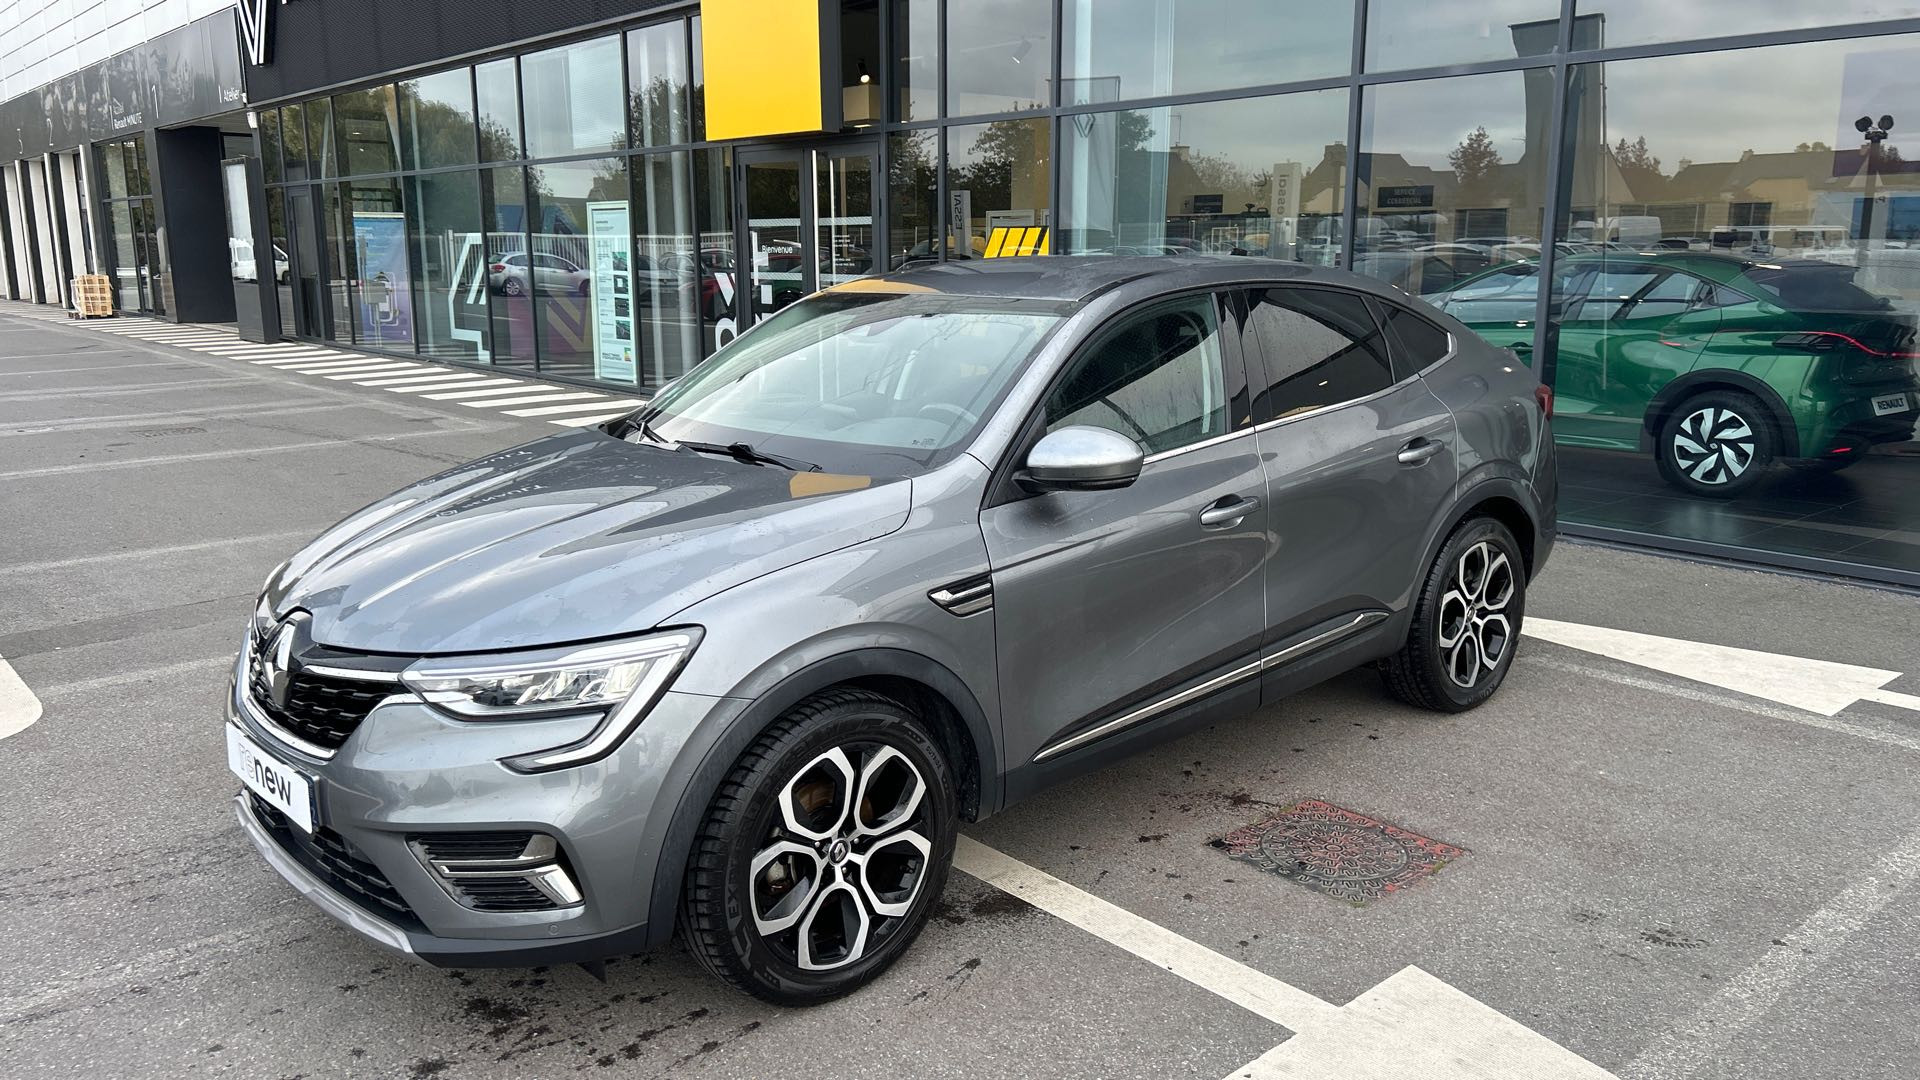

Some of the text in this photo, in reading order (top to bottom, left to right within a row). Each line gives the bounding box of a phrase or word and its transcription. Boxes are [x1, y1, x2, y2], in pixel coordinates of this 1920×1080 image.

[223, 87, 240, 102] Atelier
[761, 244, 793, 254] Bienvenue
[1876, 397, 1905, 410] RENAULT
